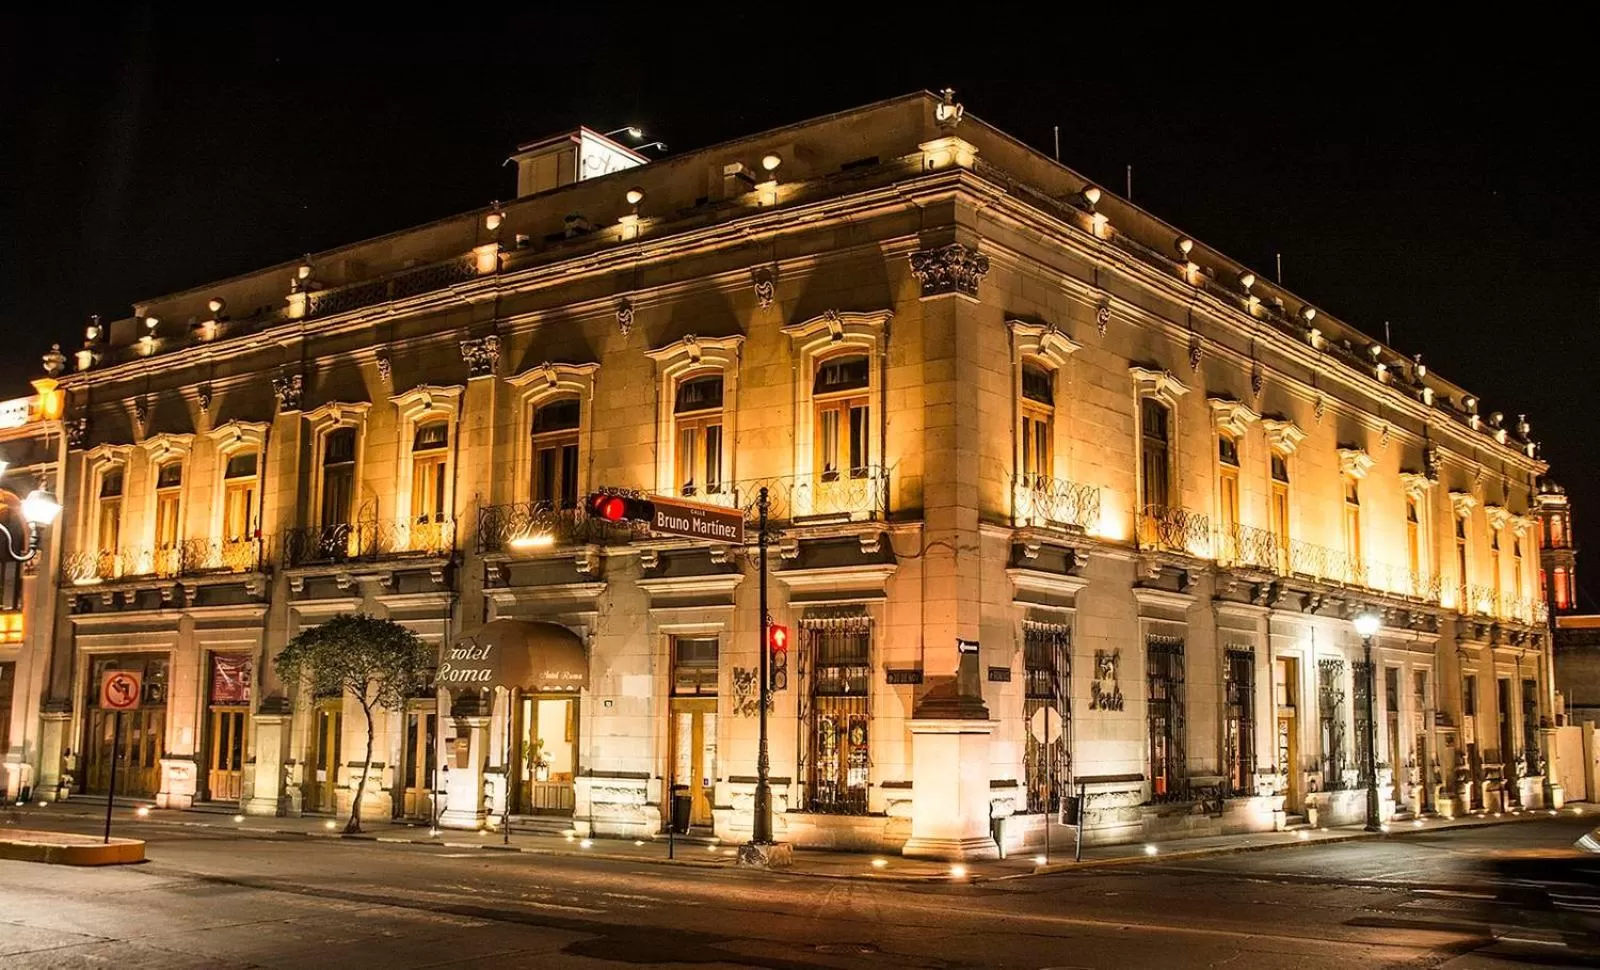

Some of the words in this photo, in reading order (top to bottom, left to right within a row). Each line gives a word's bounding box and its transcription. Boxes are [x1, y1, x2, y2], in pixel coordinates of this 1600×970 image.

[657, 511, 690, 532] Bruno
[692, 517, 737, 538] Martínez
[436, 662, 493, 682] Roma
